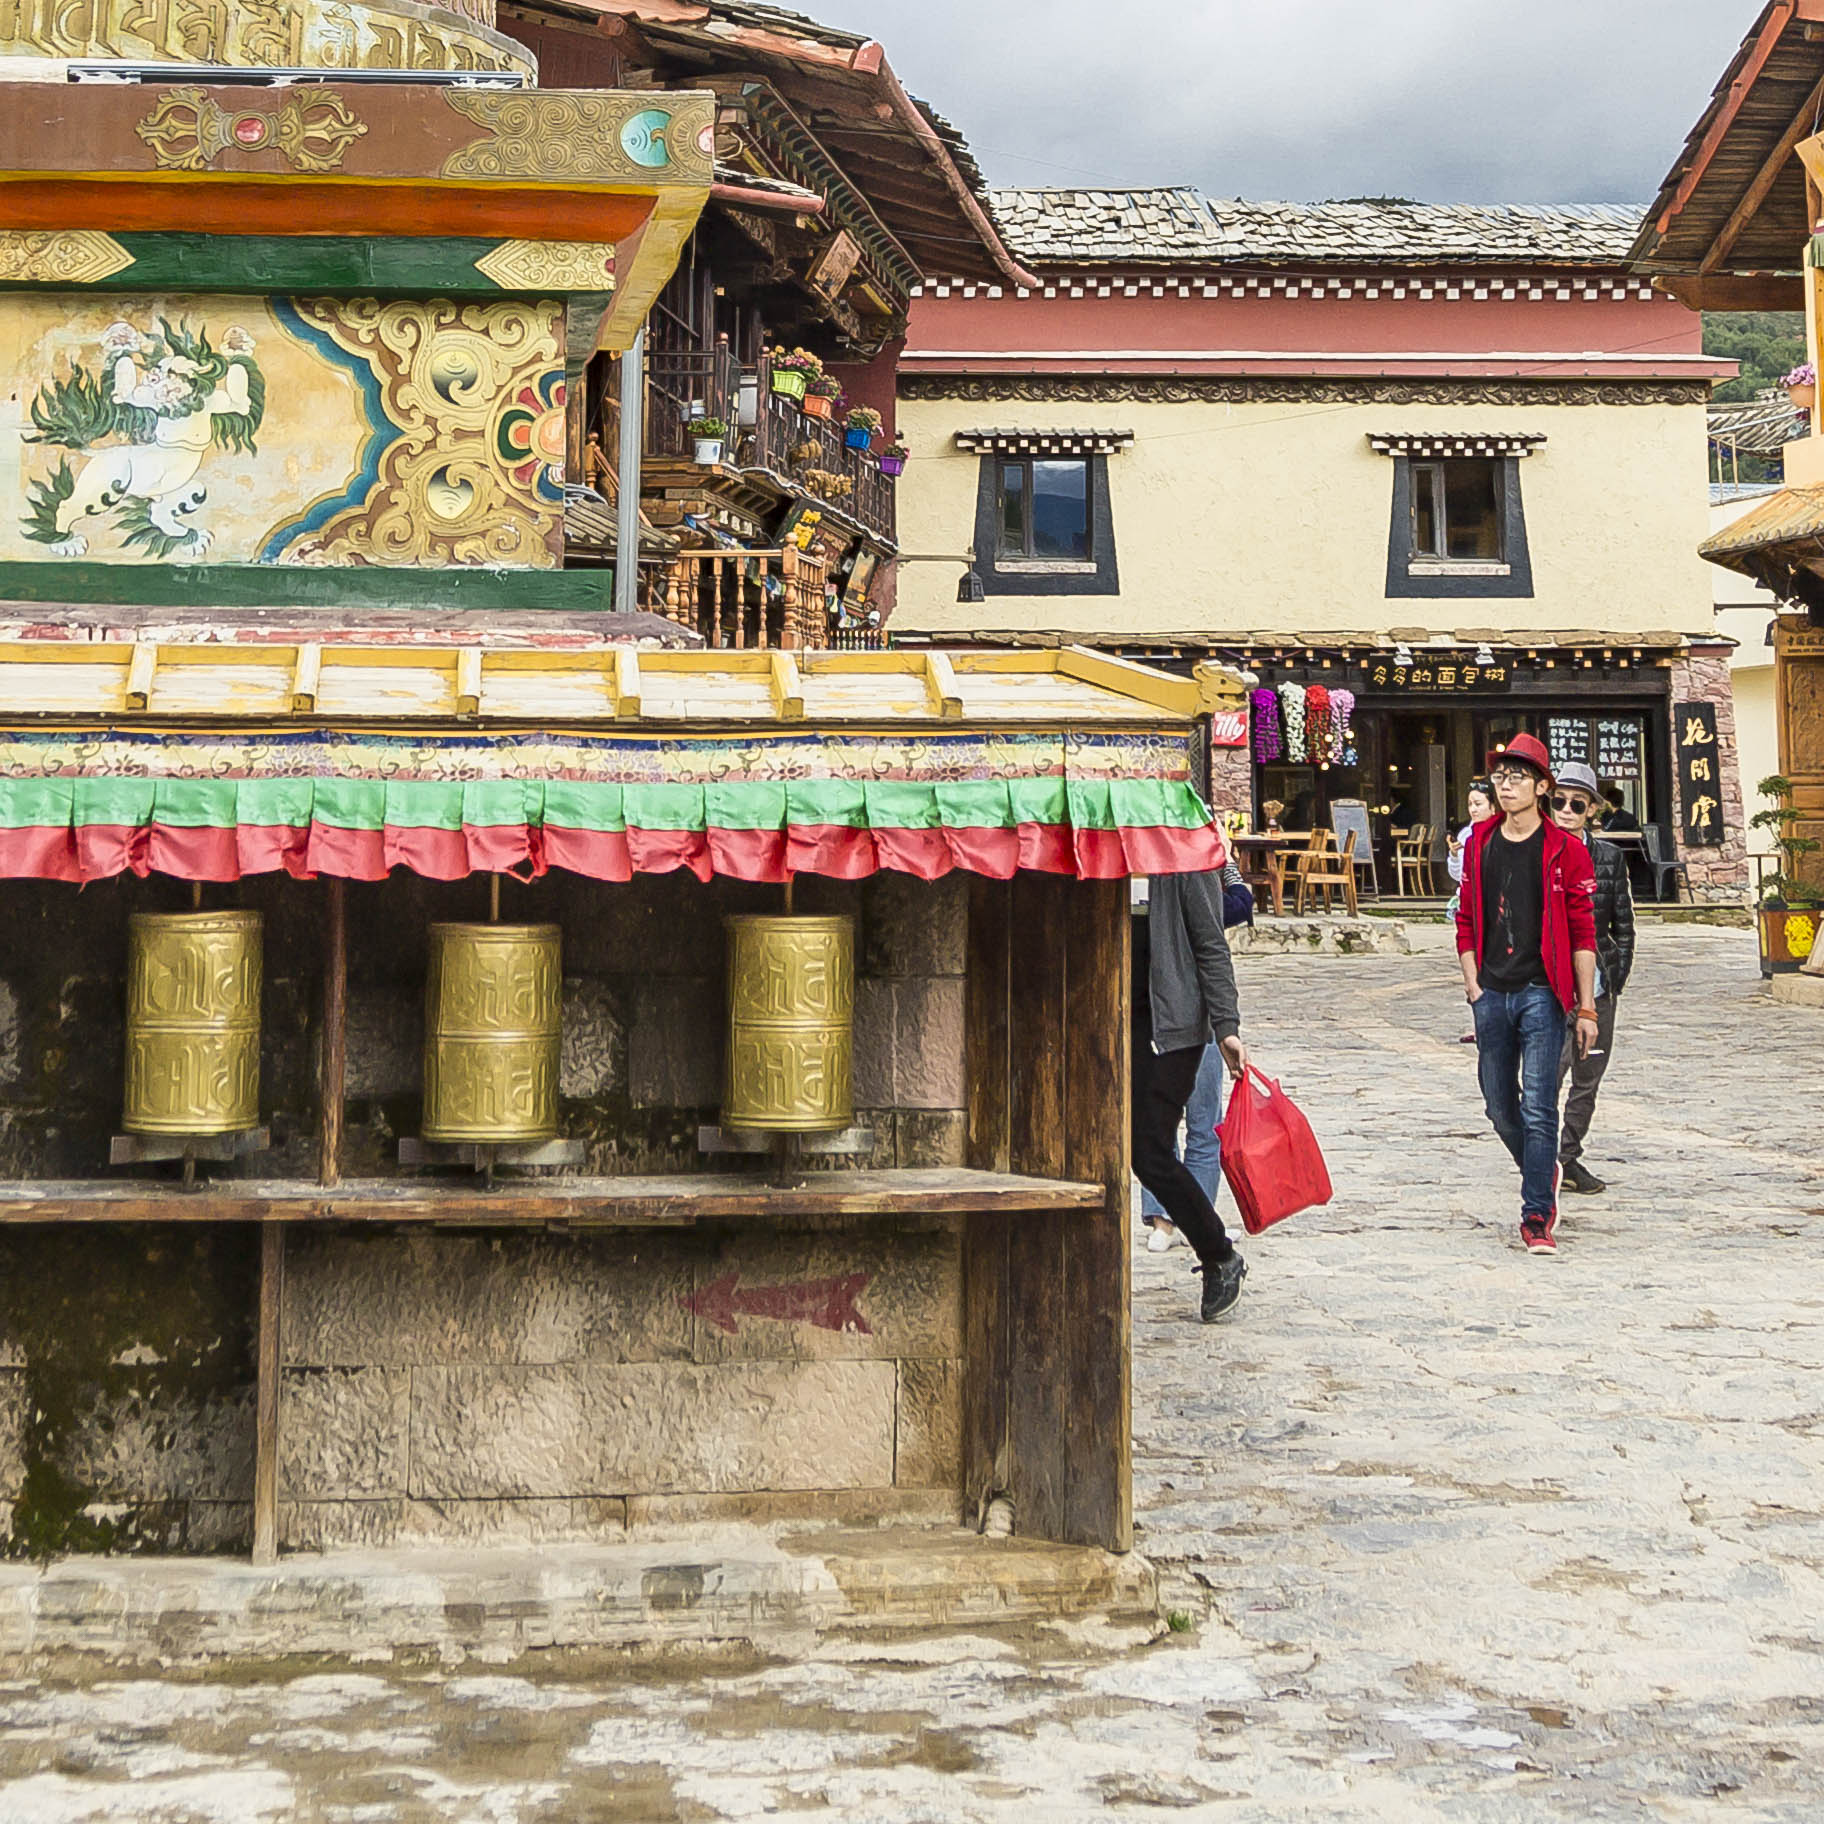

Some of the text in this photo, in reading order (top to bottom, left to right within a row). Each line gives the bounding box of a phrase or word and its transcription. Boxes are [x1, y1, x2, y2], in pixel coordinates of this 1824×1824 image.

[1373, 665, 1506, 686] 多多的面包树
[1215, 713, 1246, 742] illy
